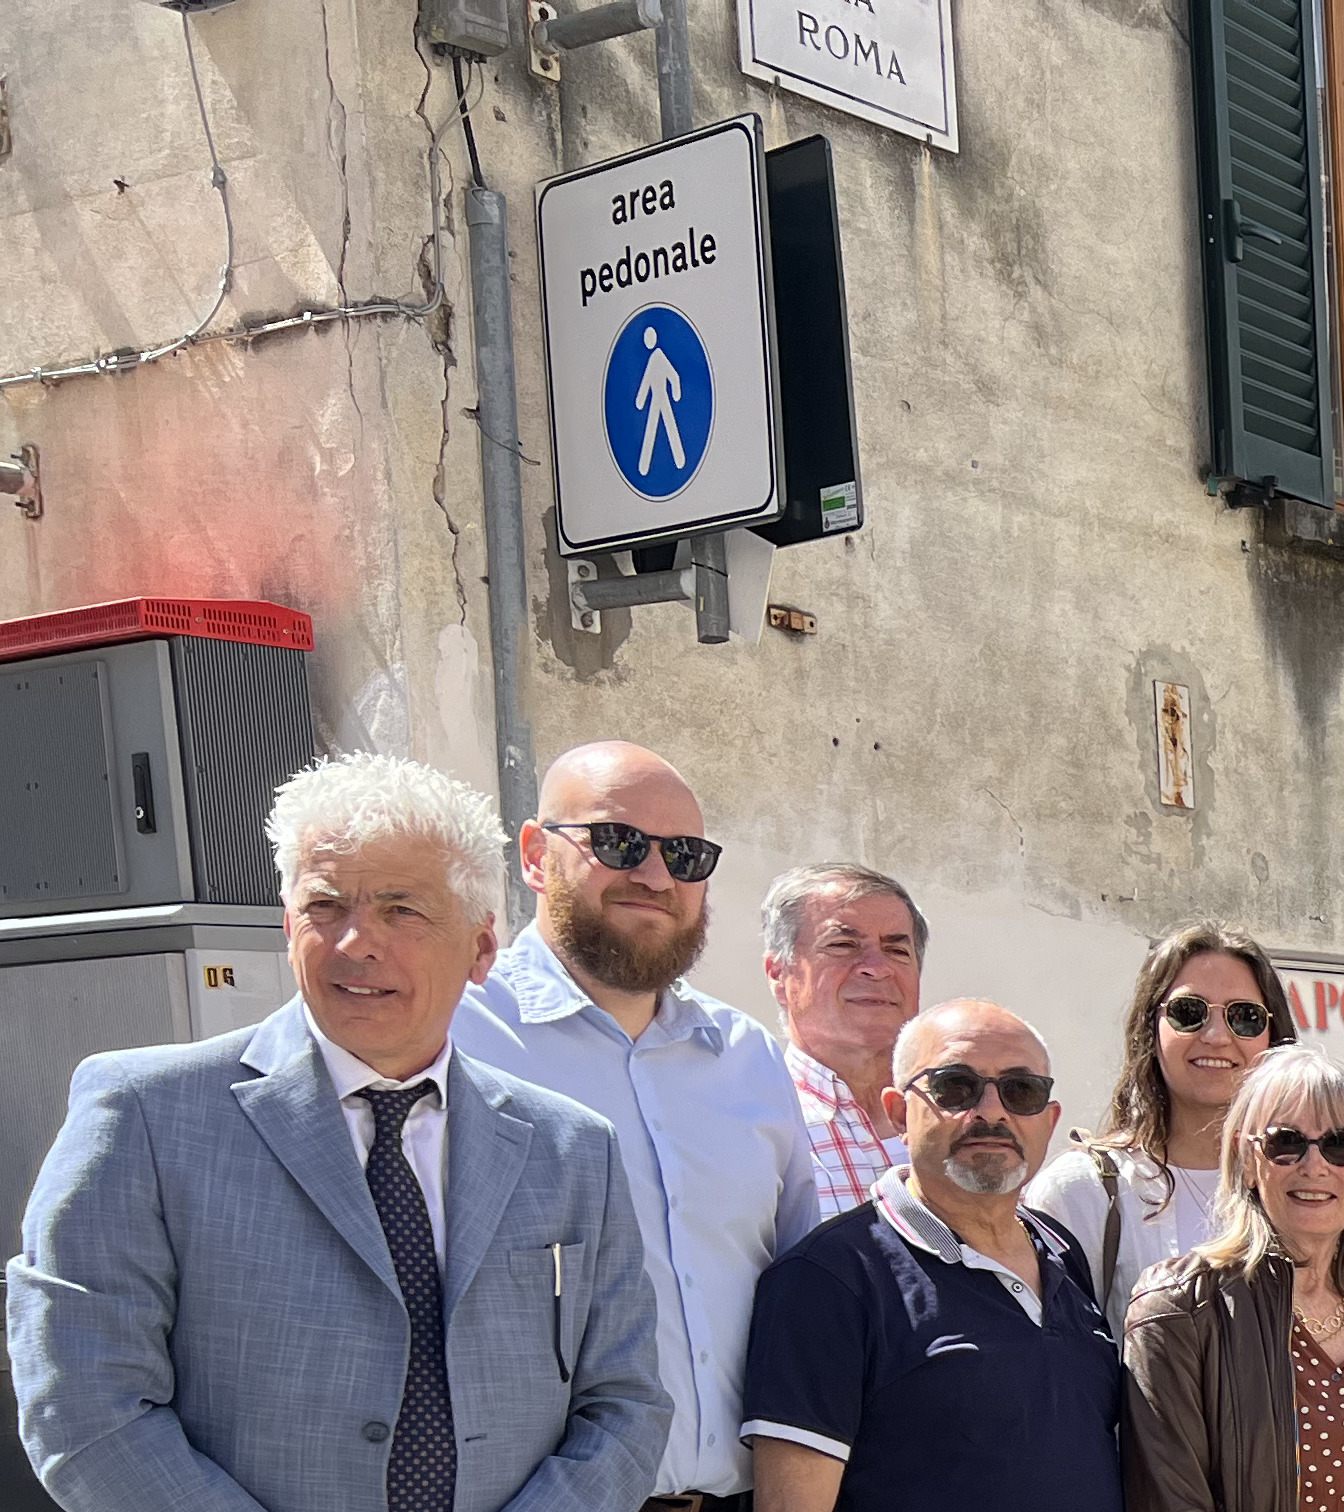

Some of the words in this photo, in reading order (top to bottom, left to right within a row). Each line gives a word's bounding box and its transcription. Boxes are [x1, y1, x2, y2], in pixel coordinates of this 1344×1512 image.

[796, 12, 907, 86] ROMA
[610, 178, 676, 225] area
[579, 227, 717, 306] pedonale
